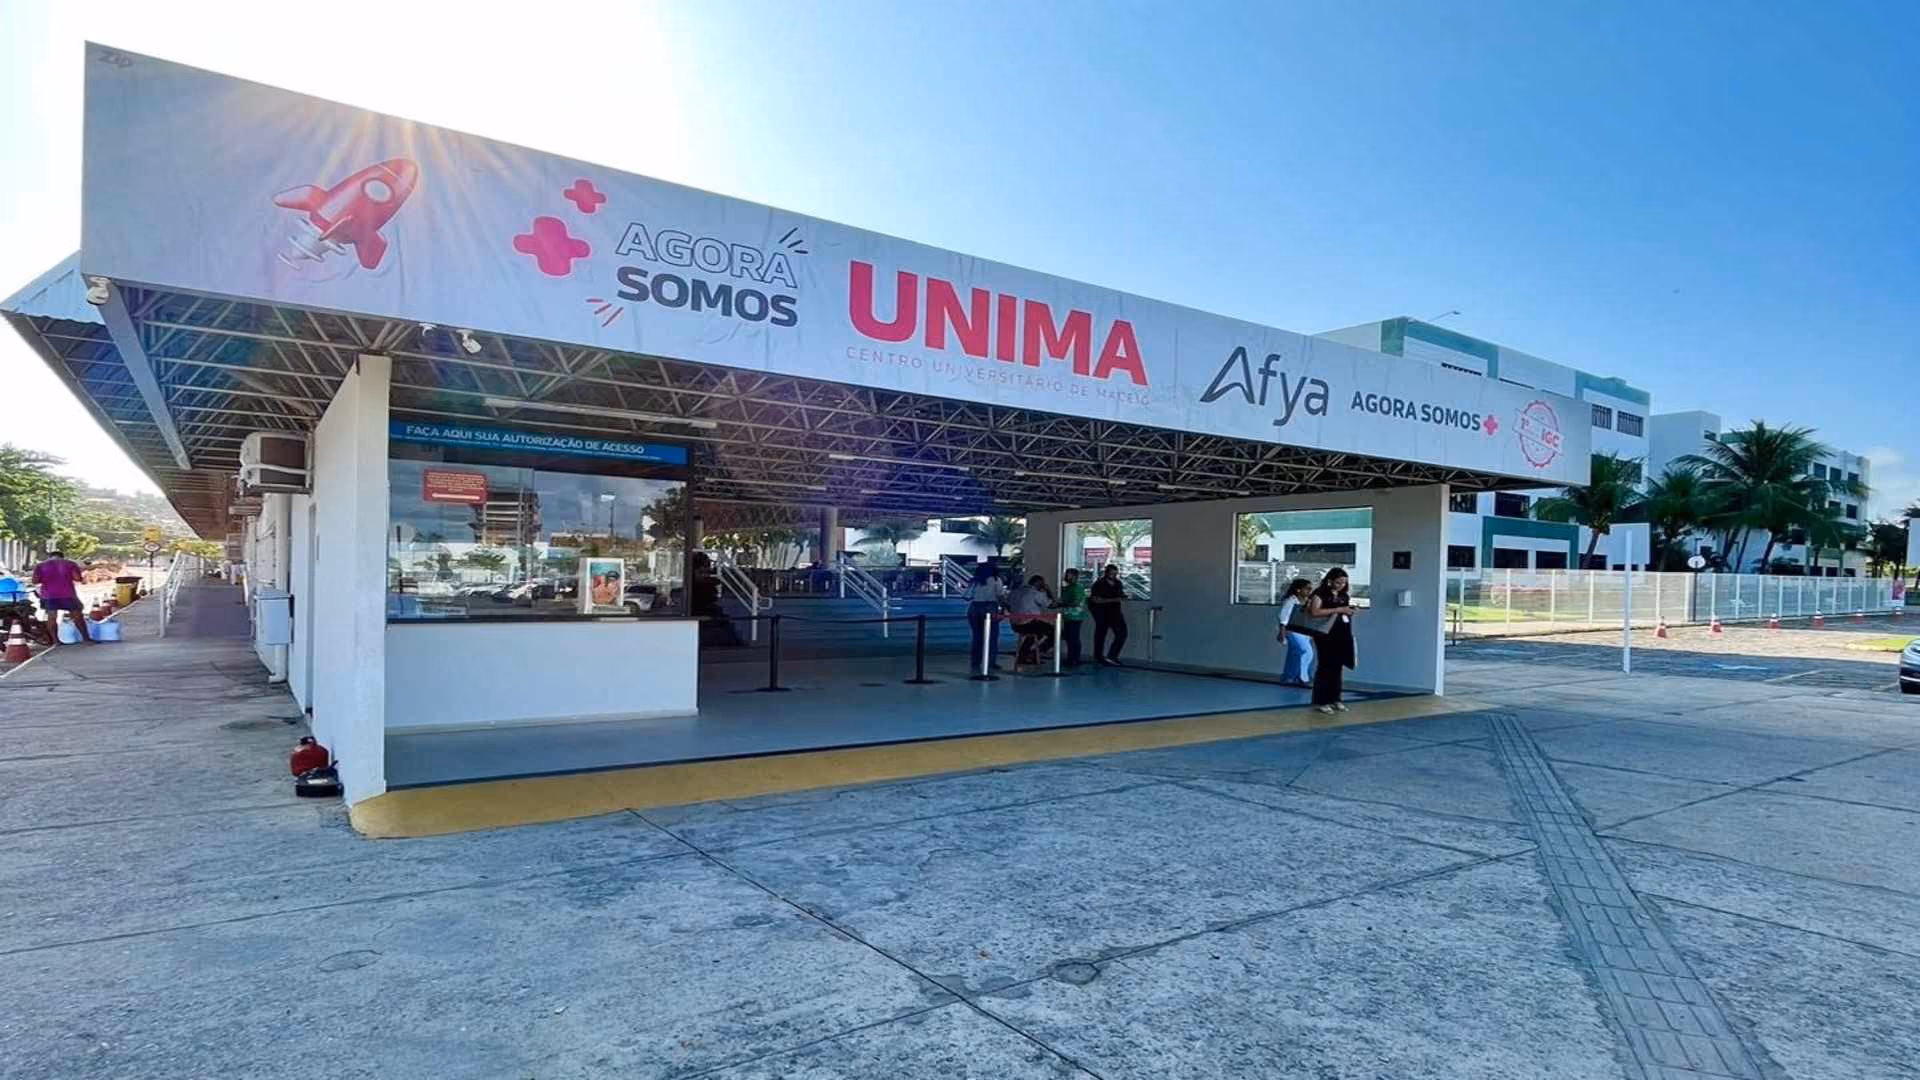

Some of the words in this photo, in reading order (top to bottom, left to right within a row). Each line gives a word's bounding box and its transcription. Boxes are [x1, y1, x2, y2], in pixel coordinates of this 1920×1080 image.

[615, 222, 797, 288] AGORA
[616, 266, 798, 327] SOMOS
[849, 259, 1149, 386] UNIMA
[846, 346, 922, 368] CENTRO
[1070, 384, 1089, 397] DE
[1199, 345, 1329, 427] Afya
[406, 425, 440, 437] FAÇA
[442, 428, 473, 440] AQUI
[474, 431, 500, 442] SUA
[502, 433, 583, 450] AUTORIZAÇÃO
[585, 440, 600, 450] DE
[602, 442, 645, 454] ACESSO
[1350, 390, 1418, 421] AGORA
[1421, 403, 1481, 432] SOMOS
